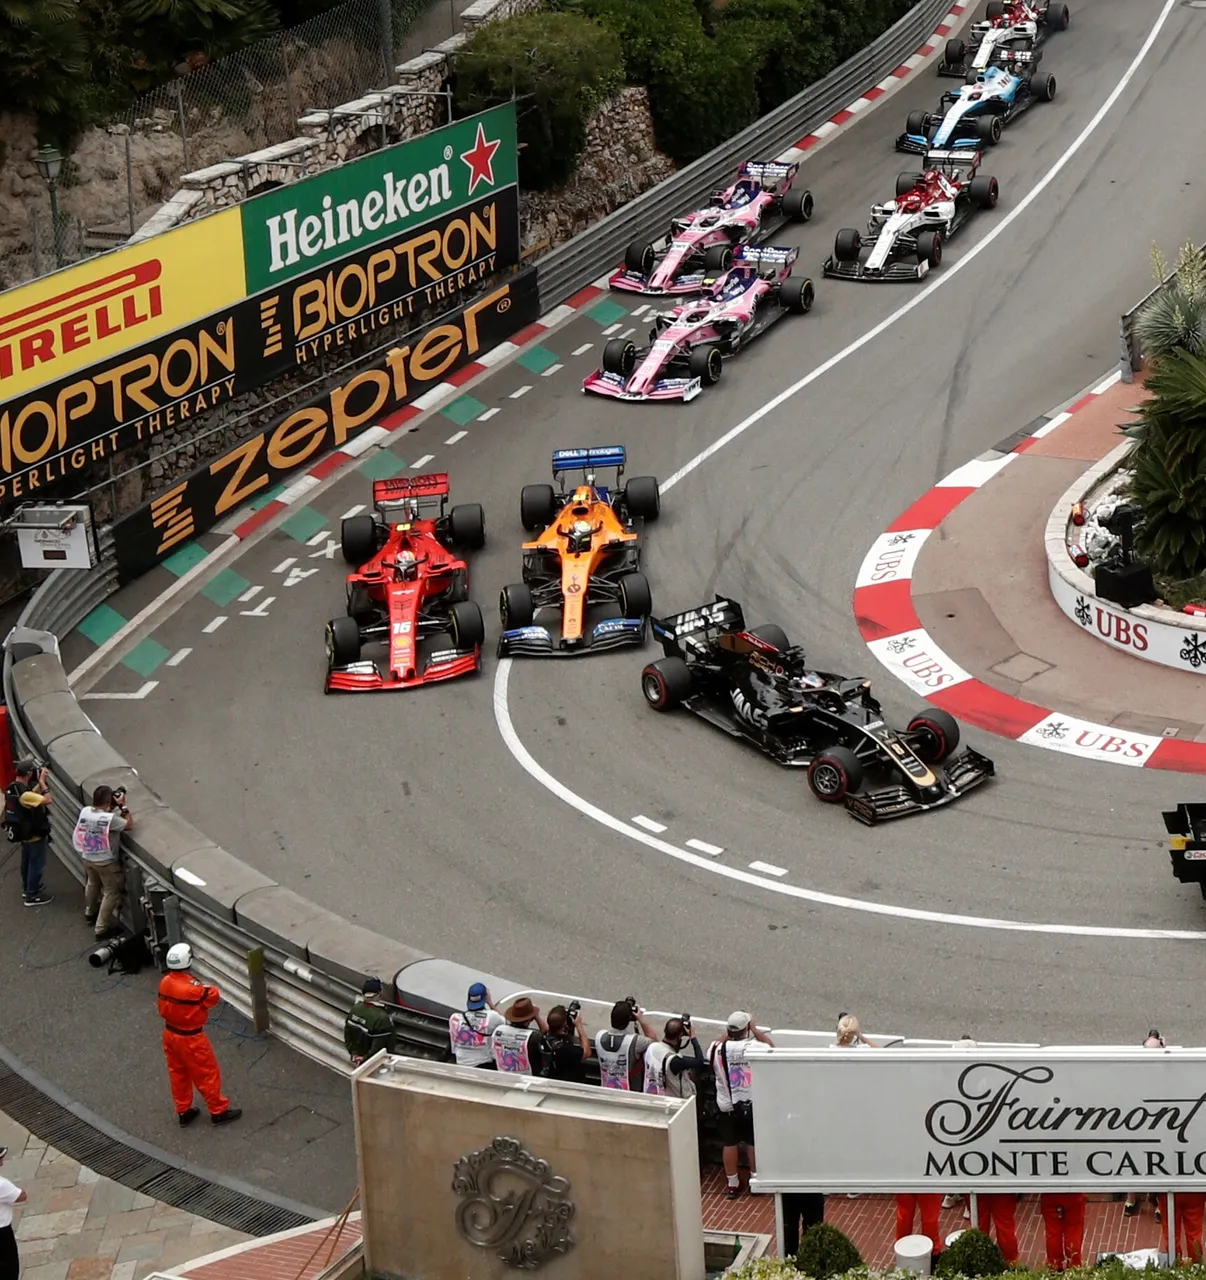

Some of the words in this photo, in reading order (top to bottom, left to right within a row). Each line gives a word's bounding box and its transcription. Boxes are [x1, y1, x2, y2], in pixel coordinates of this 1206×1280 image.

[266, 163, 453, 273] Heineken
[292, 202, 497, 341] BIOPTRON
[296, 296, 416, 365] HYPERLIGHT
[425, 256, 497, 305] THERAPY
[135, 378, 236, 440] THERAPY
[209, 283, 510, 516] zepter
[871, 547, 907, 582] UBS
[392, 621, 412, 635] 16
[1095, 609, 1149, 652] UBS
[902, 651, 955, 689] UBS
[1073, 730, 1150, 759] UBS
[923, 1151, 1069, 1177] MONTE
